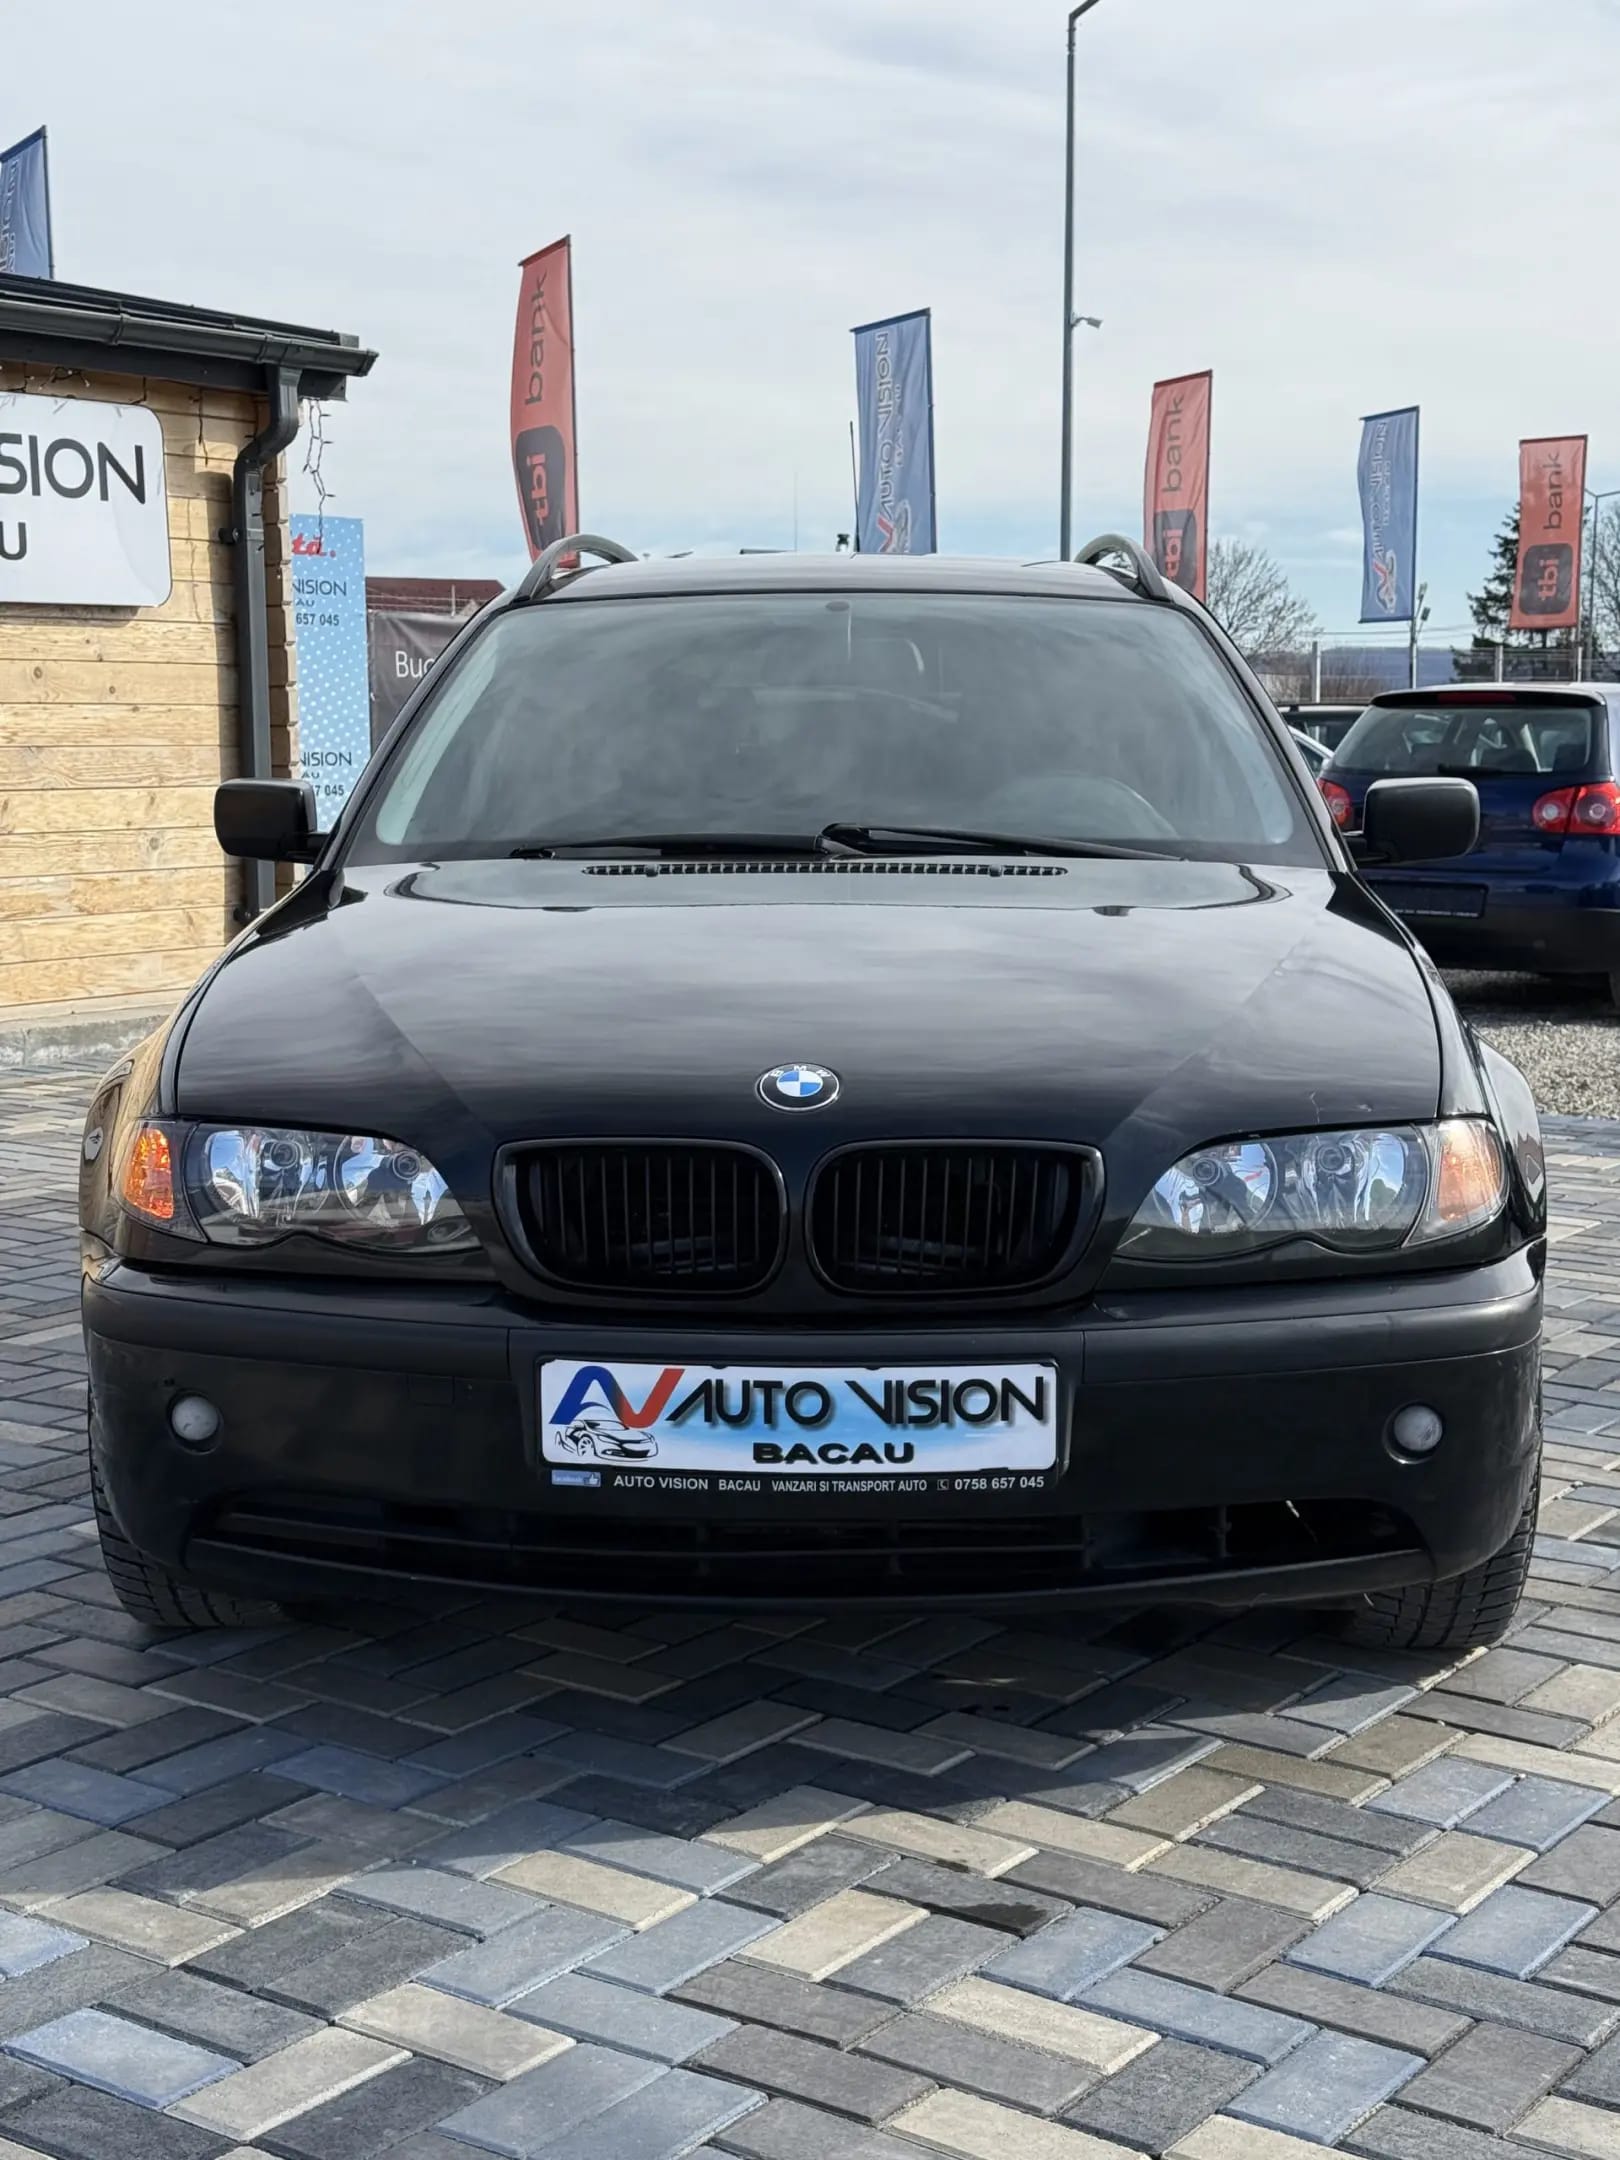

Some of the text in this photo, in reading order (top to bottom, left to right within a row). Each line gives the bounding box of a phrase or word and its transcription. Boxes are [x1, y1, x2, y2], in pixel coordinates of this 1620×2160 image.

[525, 271, 550, 527] tbi bank
[875, 332, 893, 437] VISION
[1162, 393, 1185, 493] bank
[0, 433, 146, 504] SION
[1537, 452, 1562, 601] tbi bank
[296, 612, 340, 626] 657 045
[324, 784, 345, 796] 045
[768, 1065, 832, 1078] BMW
[665, 1376, 1045, 1426] AUTO VISION
[752, 1442, 915, 1465] BACAU
[613, 1475, 1045, 1492] AUTO VISION BACAU VANZARI SI TRANSPORT AUTO 0758 657 045
